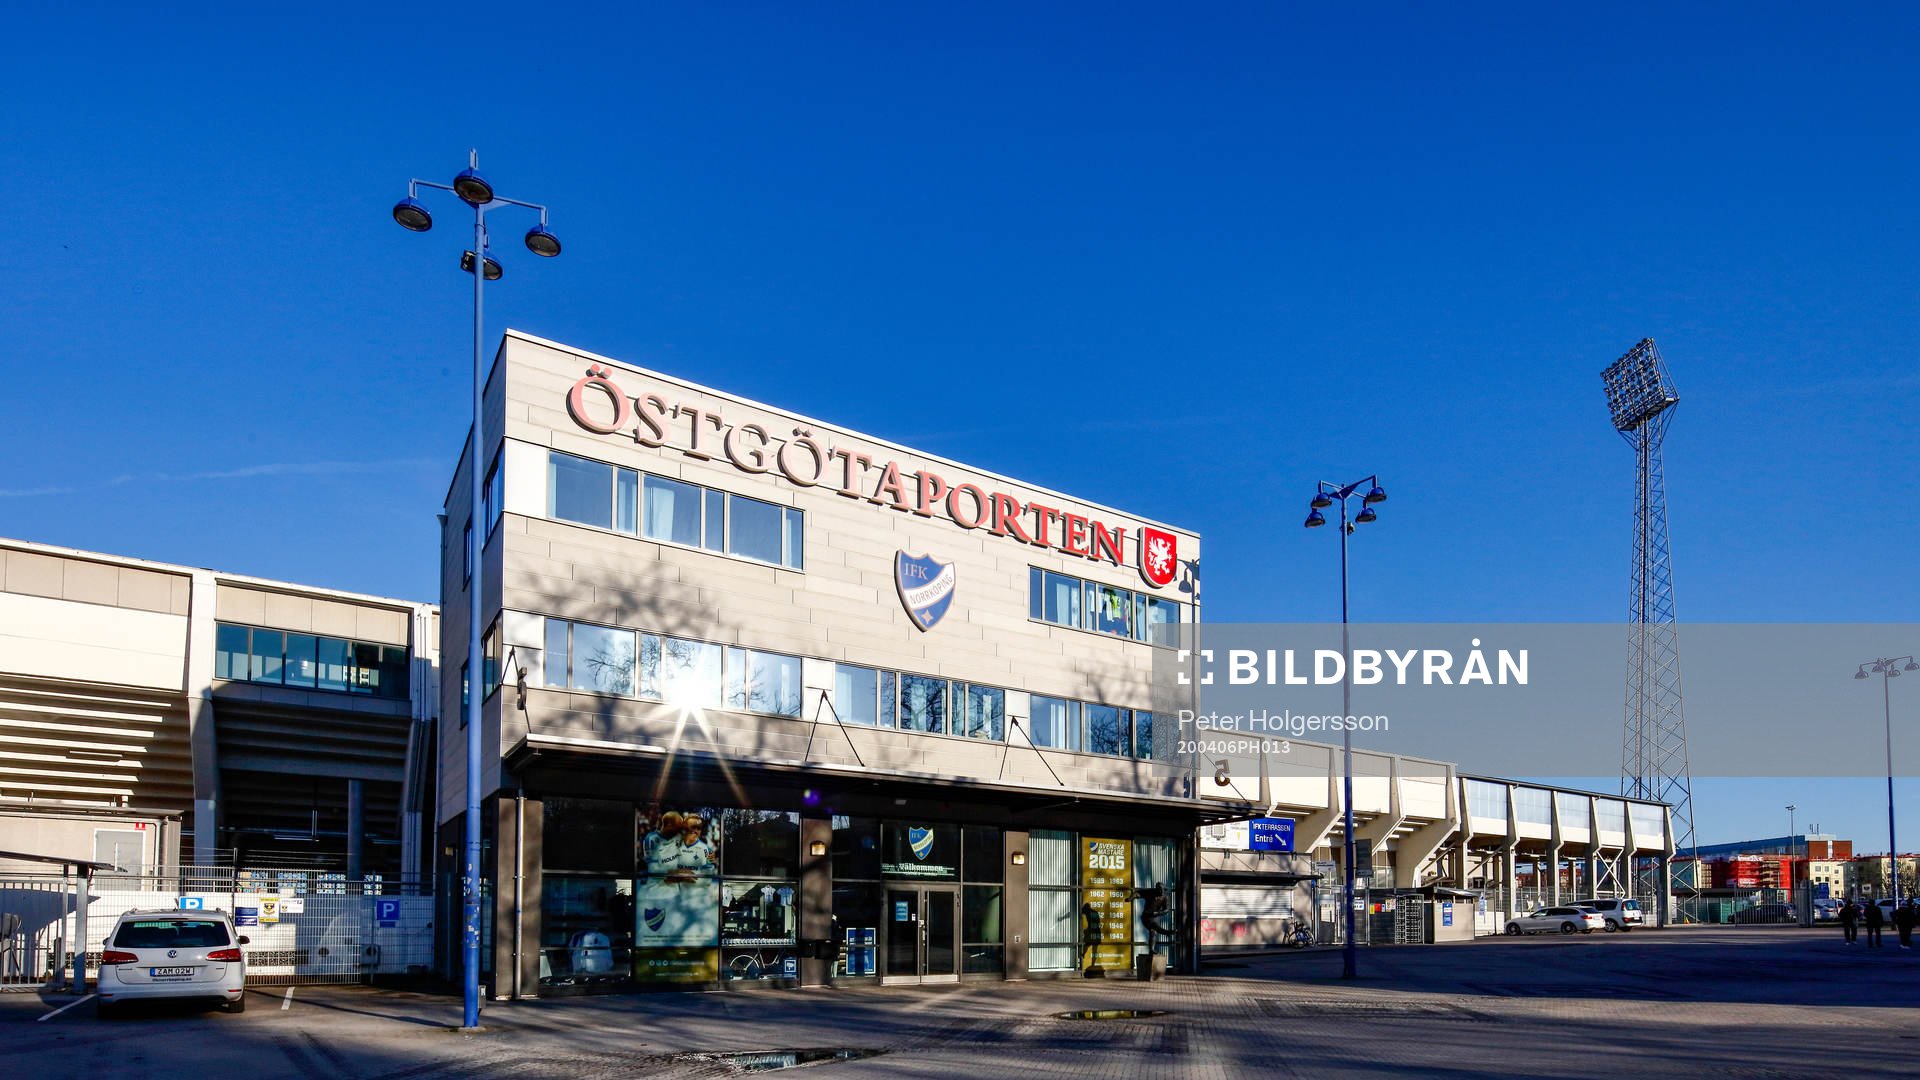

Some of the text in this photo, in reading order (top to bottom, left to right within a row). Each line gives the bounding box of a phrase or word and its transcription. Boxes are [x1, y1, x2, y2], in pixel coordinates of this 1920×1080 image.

[566, 363, 1127, 567] ÖSTGÖTAPORTEN
[904, 562, 928, 580] IFK
[1255, 834, 1273, 843] Entré
[1089, 854, 1125, 870] 2015
[383, 903, 395, 917] P
